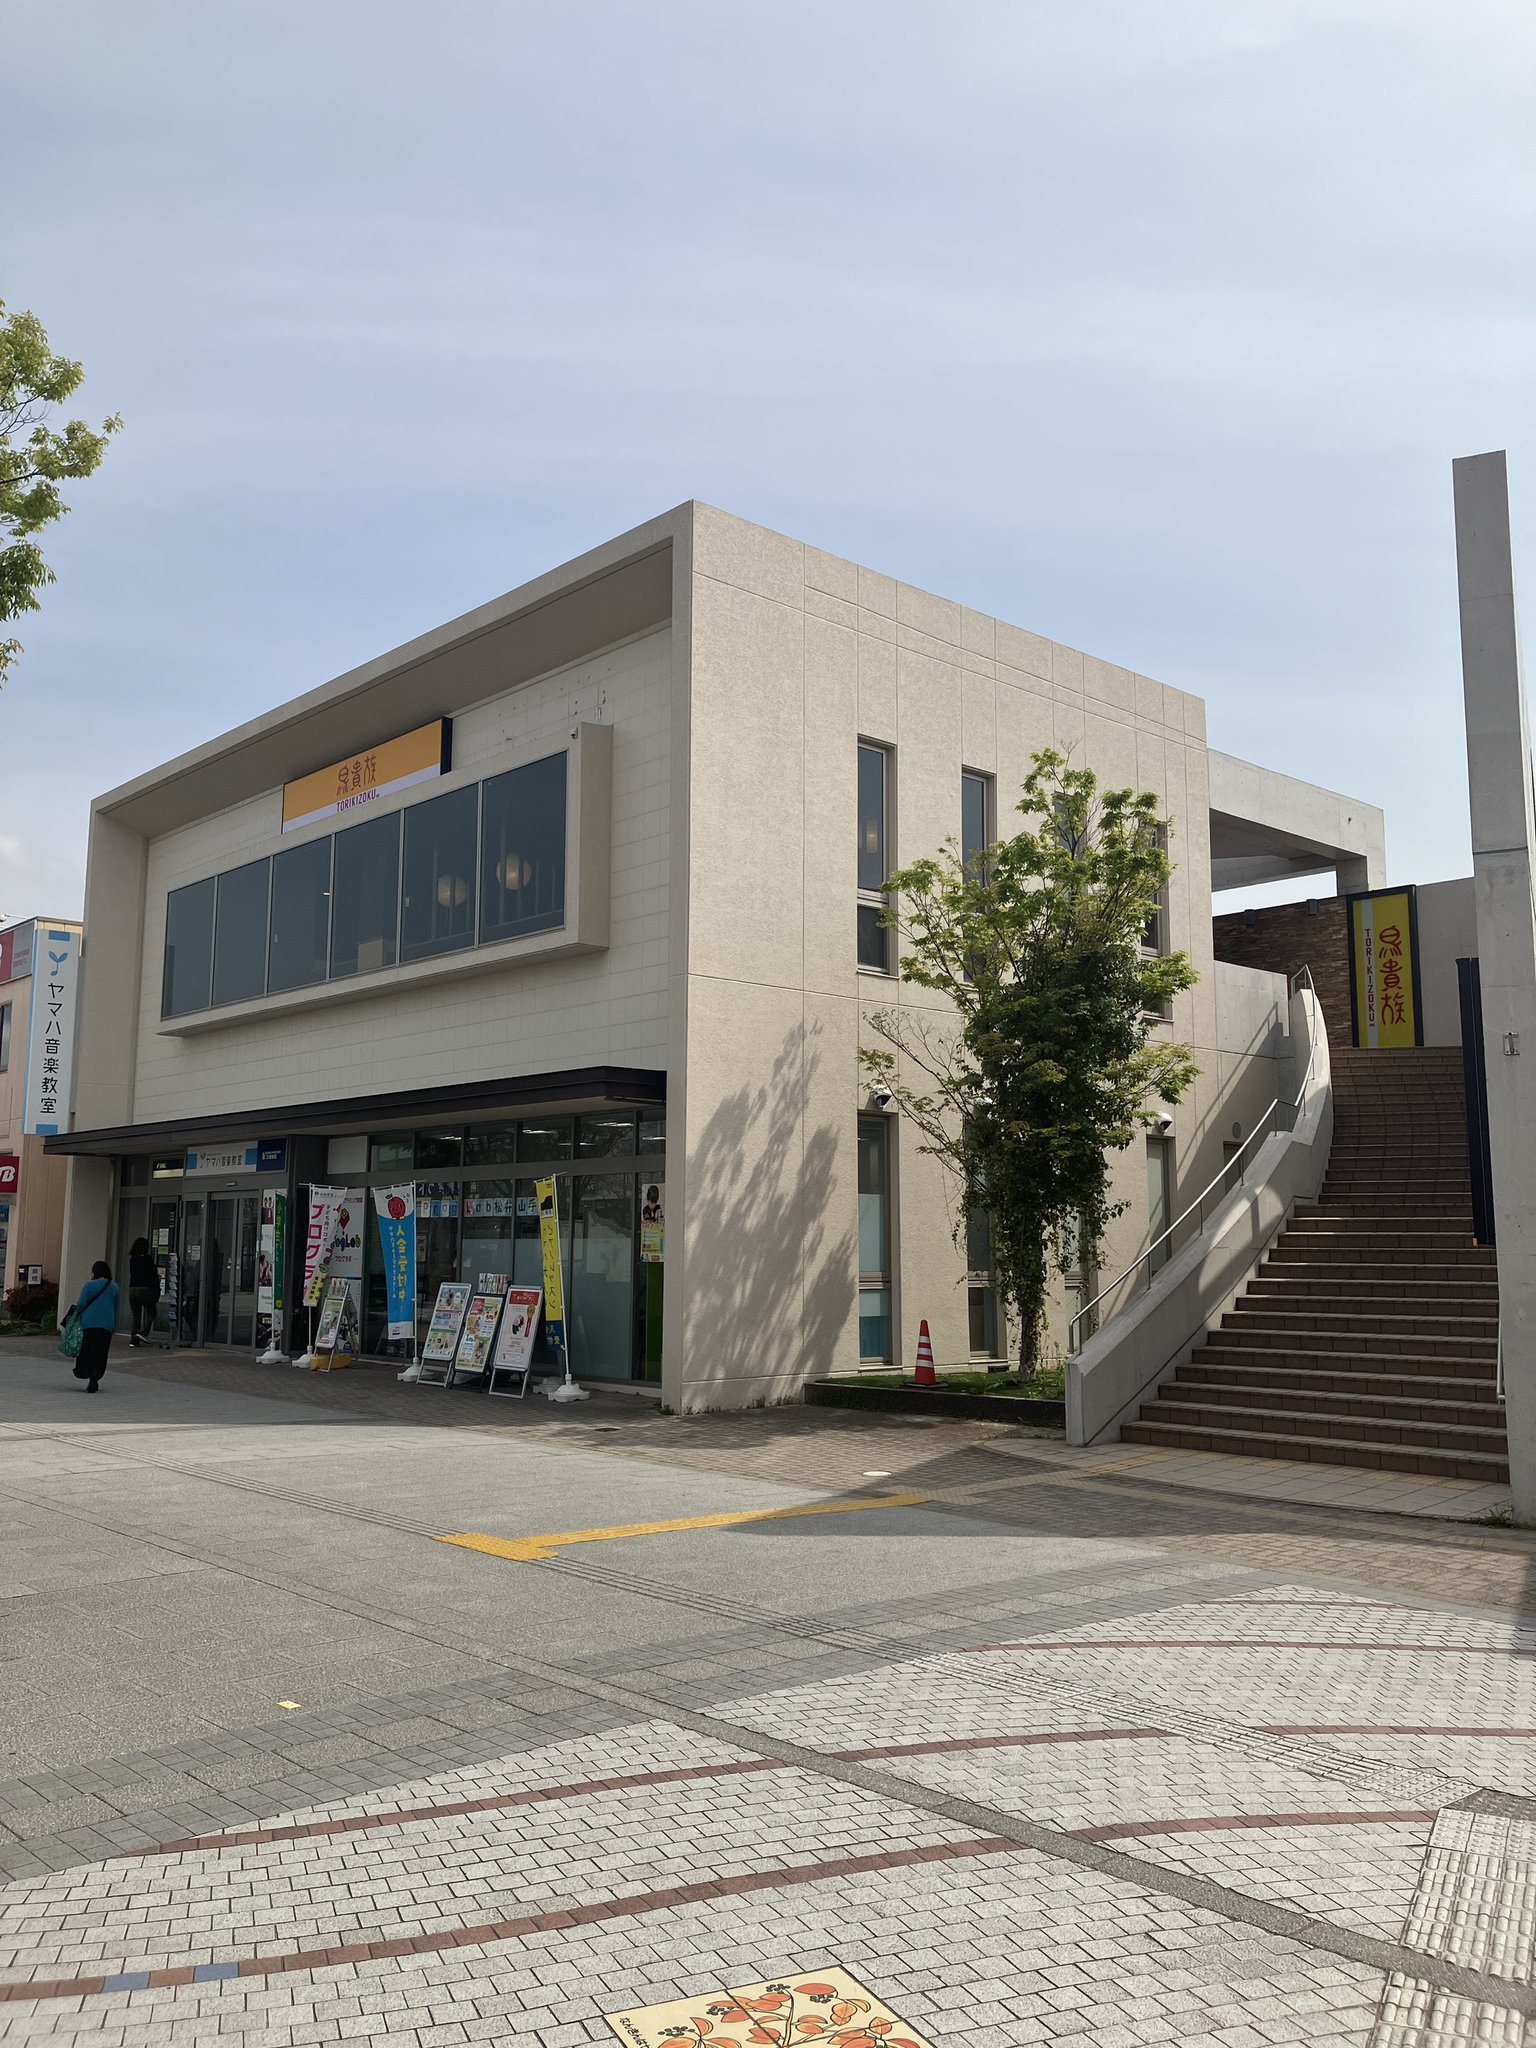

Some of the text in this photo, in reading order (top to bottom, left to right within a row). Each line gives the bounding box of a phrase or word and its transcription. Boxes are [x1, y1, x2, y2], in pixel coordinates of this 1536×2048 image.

[336, 788, 377, 813] TORIKIZOKU
[1365, 928, 1376, 1022] TORIKIZOKU
[40, 982, 64, 1114] ヤマハ音楽教室
[206, 1155, 243, 1168] ヤマハ音楽教室
